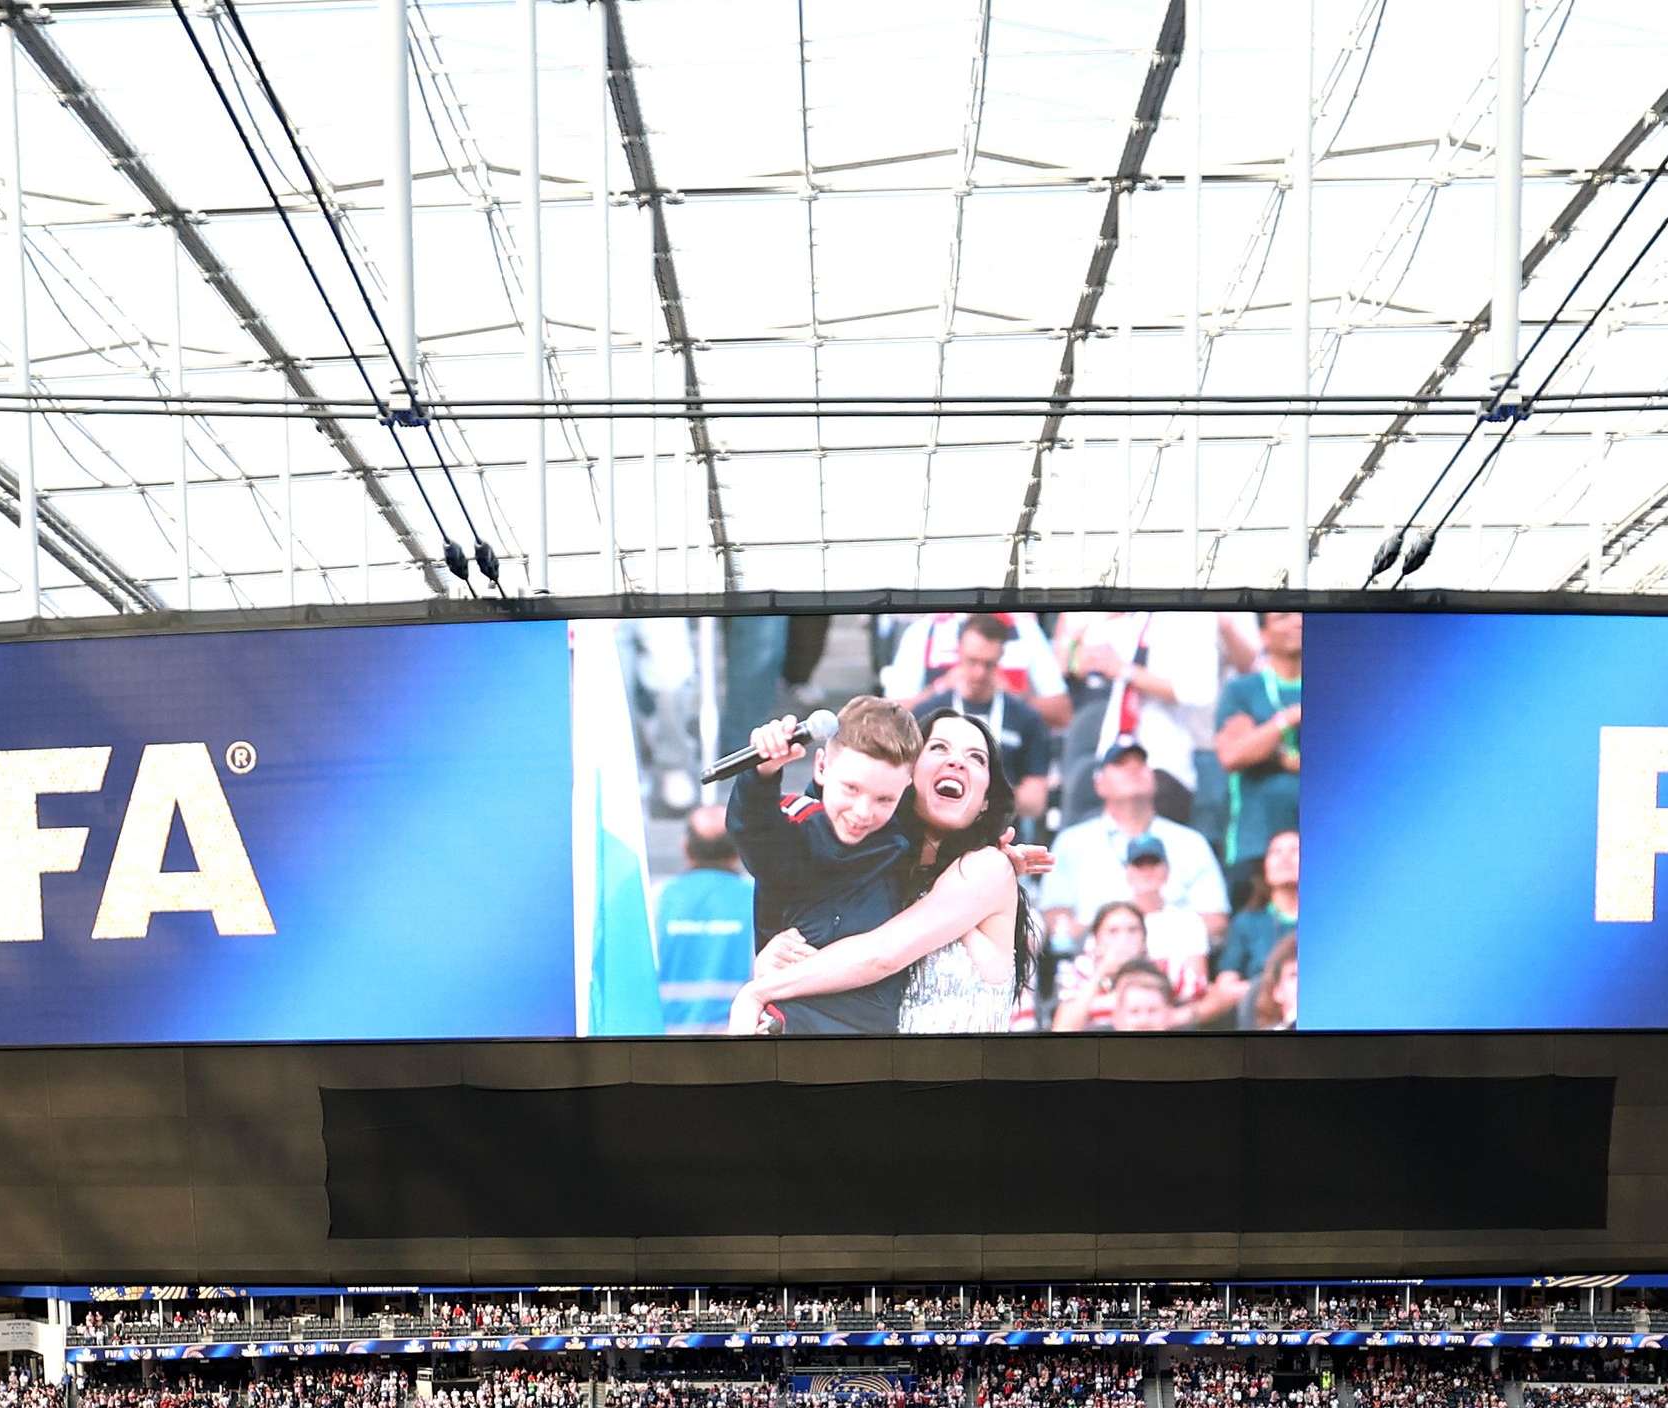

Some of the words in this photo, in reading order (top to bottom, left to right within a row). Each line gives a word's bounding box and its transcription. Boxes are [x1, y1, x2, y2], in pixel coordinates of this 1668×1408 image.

[751, 1336, 770, 1345] FIFA
[960, 1334, 979, 1344] FIFA
[1282, 1334, 1300, 1344] FIFA
[270, 1345, 289, 1355] FIFA
